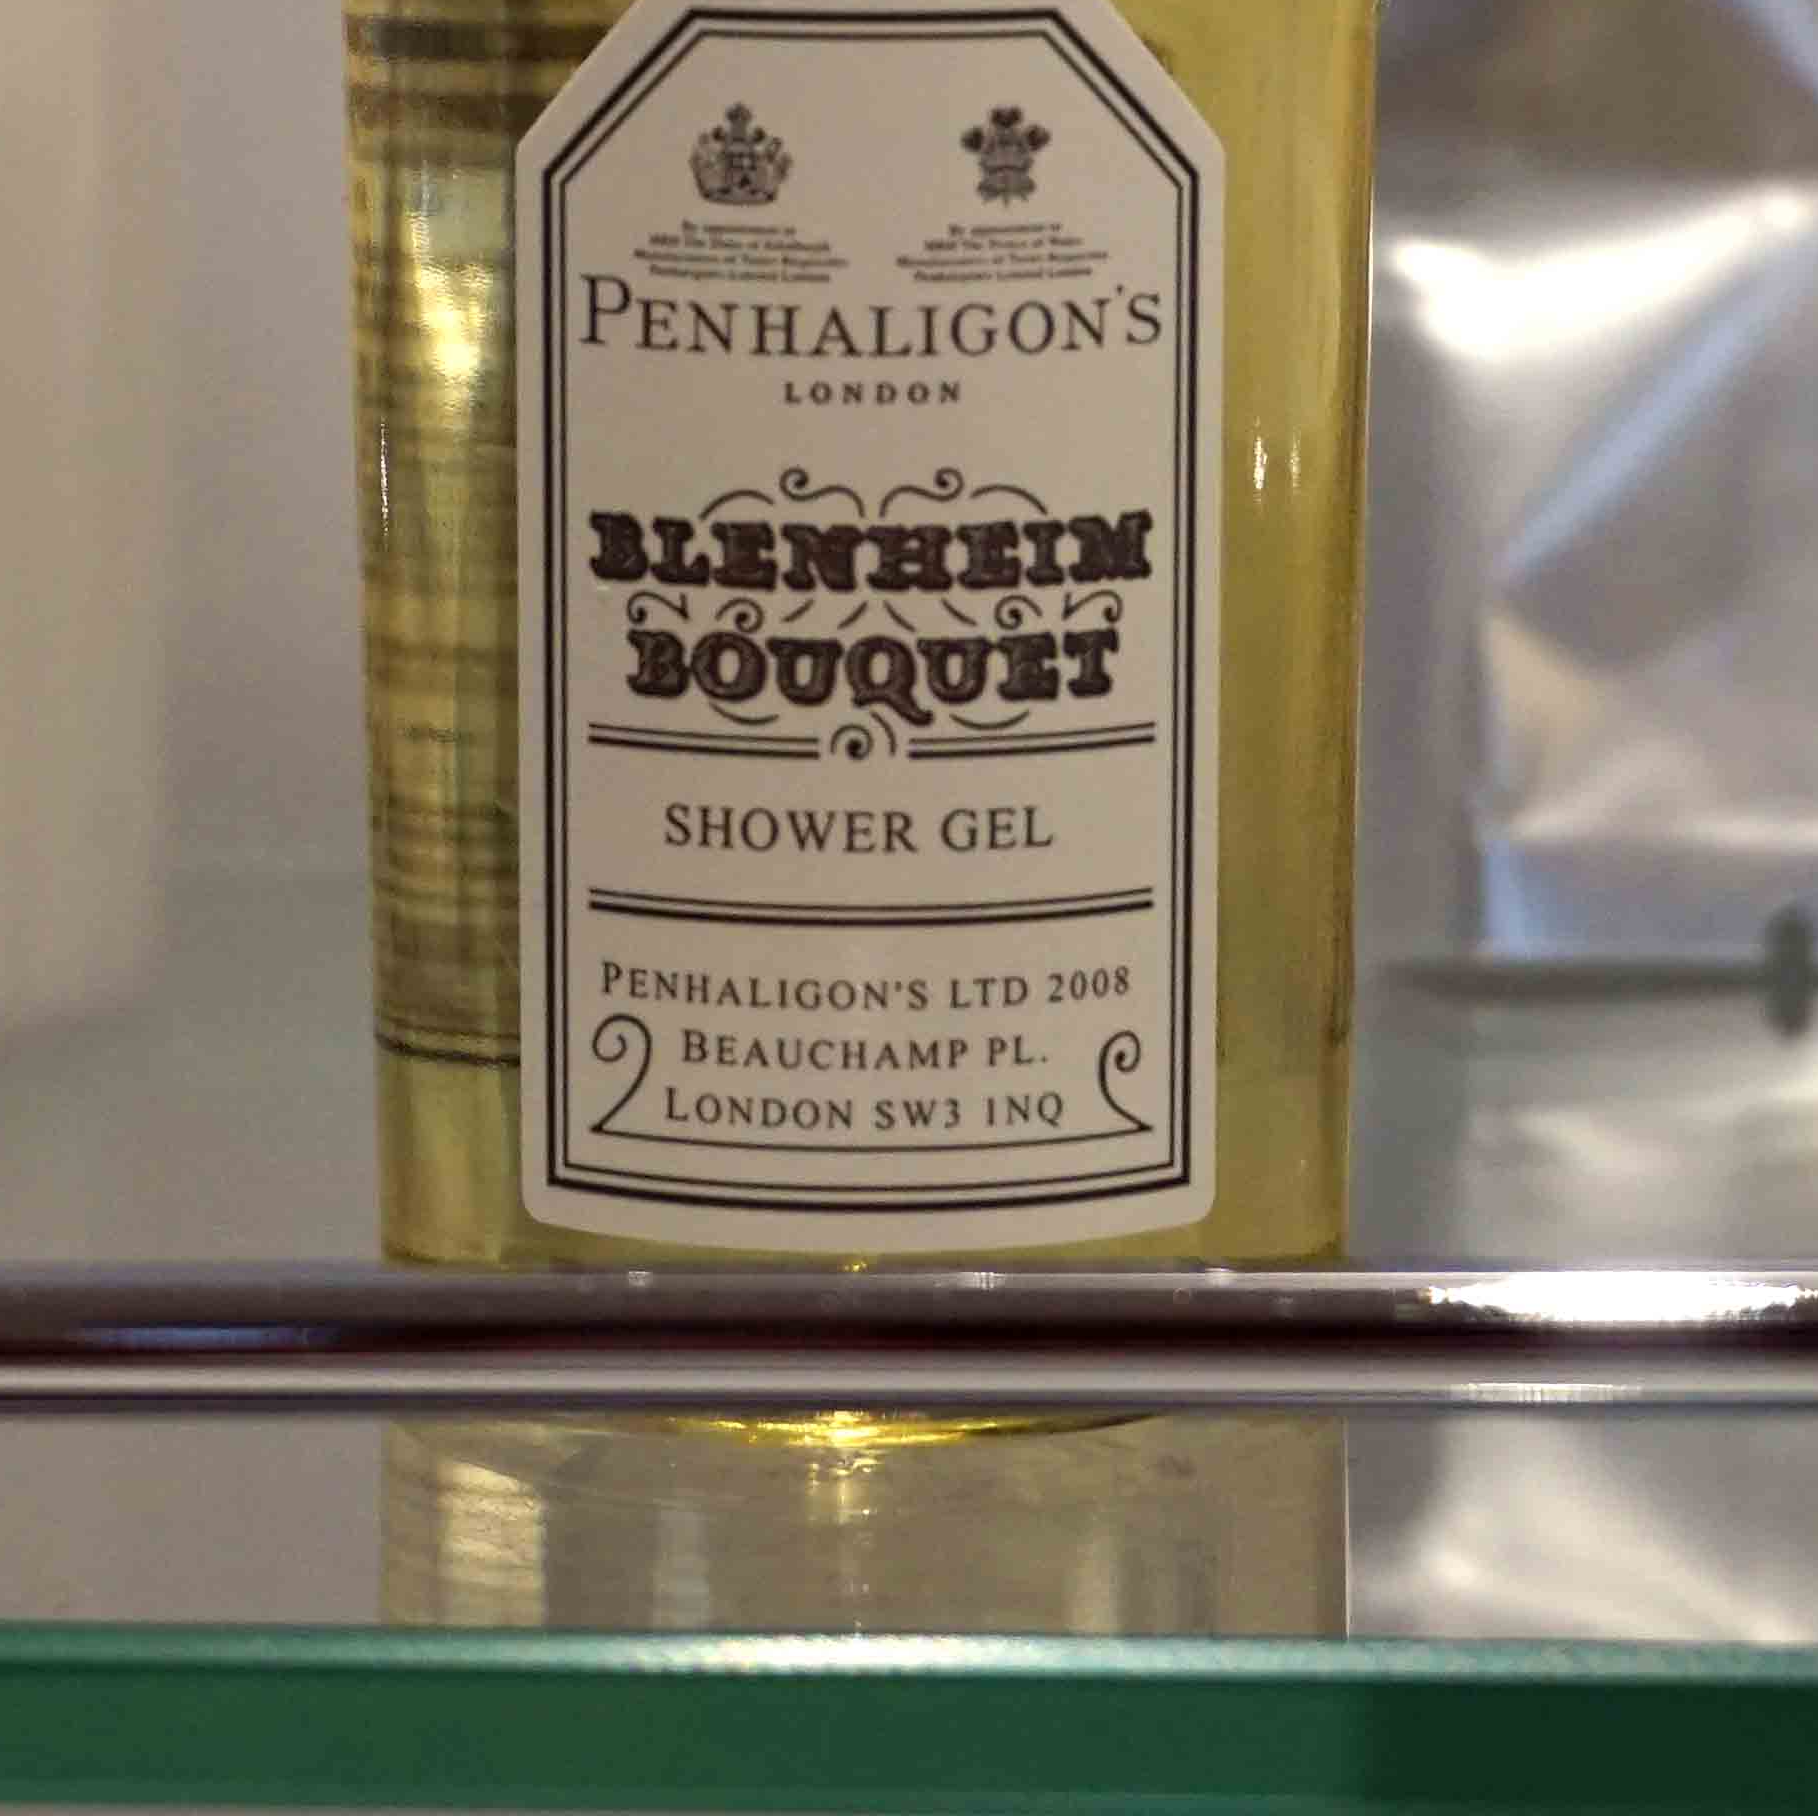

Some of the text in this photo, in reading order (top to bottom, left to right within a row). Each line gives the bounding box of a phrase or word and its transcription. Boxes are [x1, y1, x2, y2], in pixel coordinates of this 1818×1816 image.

[581, 274, 1162, 359] PENHALIGON'S
[785, 381, 961, 407] LONDON
[588, 509, 1154, 591] BLENHEIM
[626, 628, 1121, 727] BOUQUET
[664, 803, 1055, 855] SHOWER GEL
[601, 961, 1132, 1012] PENHALIGON'S LTD 2008
[682, 1029, 1049, 1072] BEAUCHAMP PL.
[665, 1086, 854, 1132] LONDON
[875, 1098, 962, 1133] SW3
